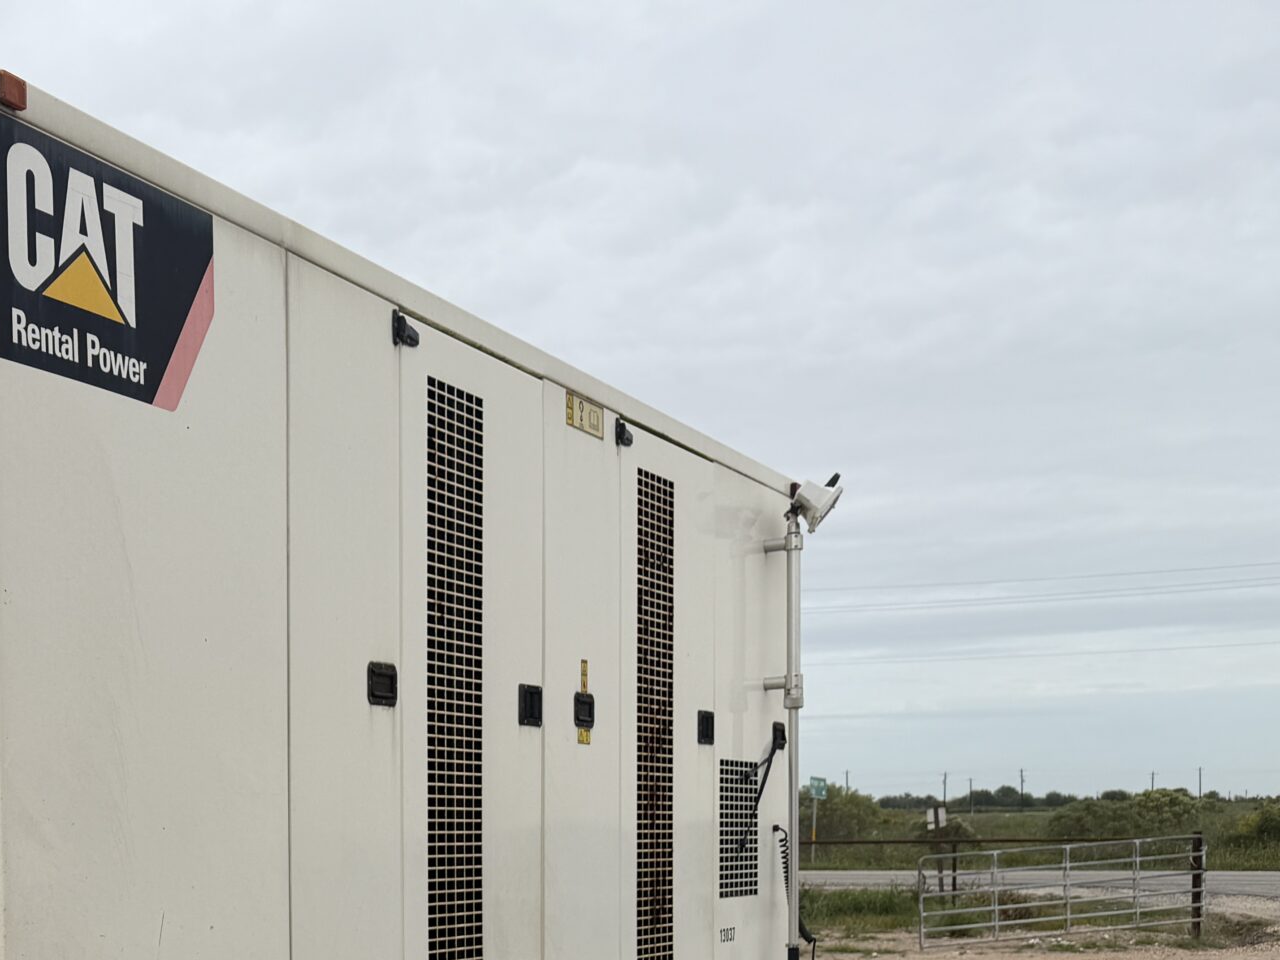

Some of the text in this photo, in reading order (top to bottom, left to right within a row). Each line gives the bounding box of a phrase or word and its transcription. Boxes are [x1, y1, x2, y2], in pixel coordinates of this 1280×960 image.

[6, 142, 144, 328] CAT
[11, 306, 147, 385] Rental Power
[720, 926, 735, 943] 13037
